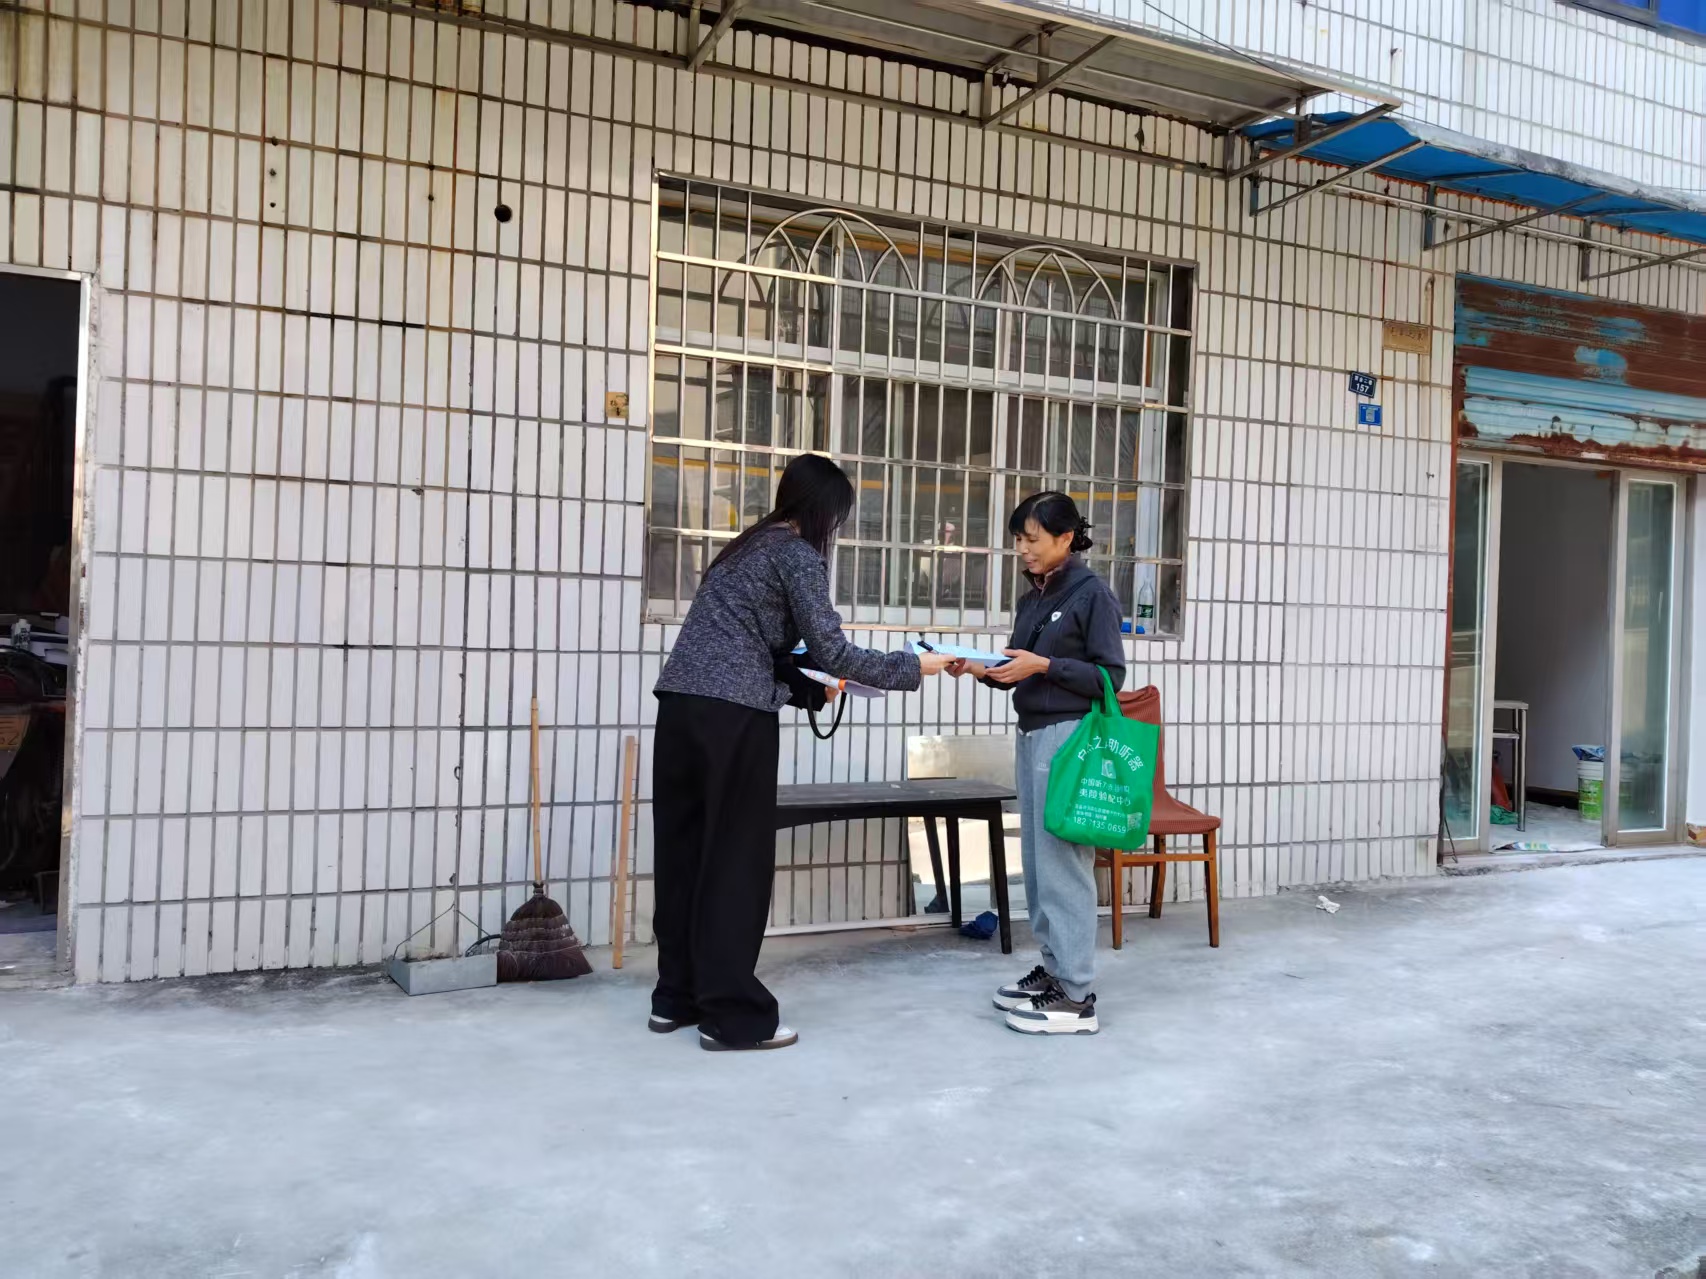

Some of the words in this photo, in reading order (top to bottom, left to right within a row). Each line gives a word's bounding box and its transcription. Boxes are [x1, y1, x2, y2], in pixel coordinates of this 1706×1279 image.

[1356, 383, 1370, 393] 157
[1073, 816, 1086, 826] 182
[1107, 823, 1126, 834] 0659
